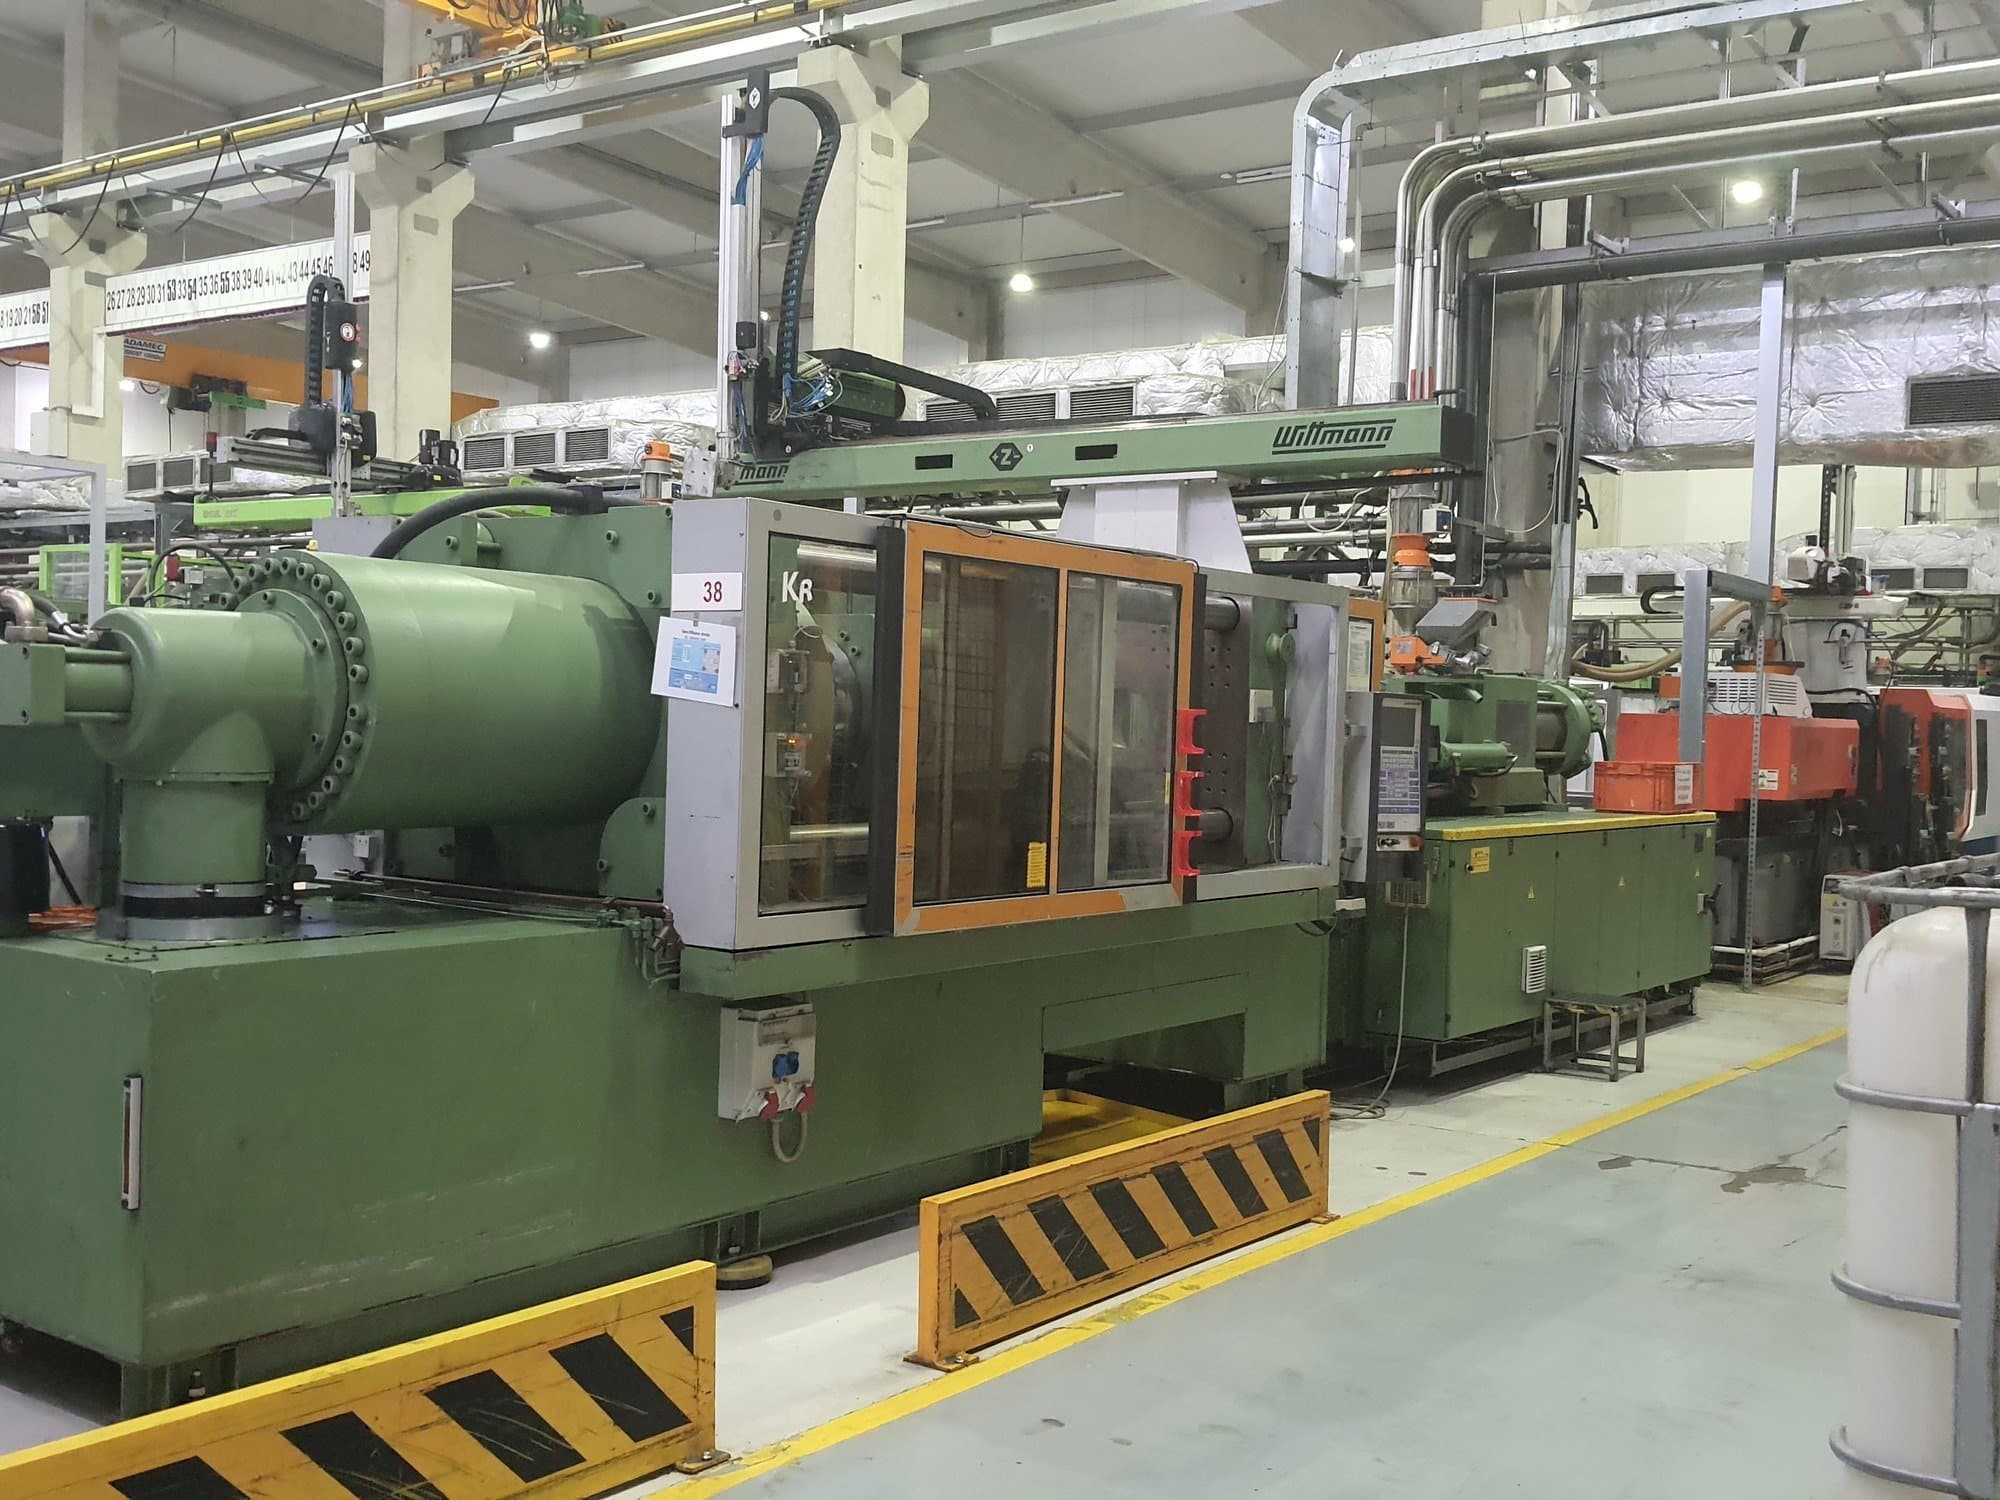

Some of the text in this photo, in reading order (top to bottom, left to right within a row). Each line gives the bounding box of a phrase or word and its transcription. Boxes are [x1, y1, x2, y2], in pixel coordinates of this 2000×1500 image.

[107, 291, 115, 311] 26
[117, 289, 125, 309] 27
[127, 287, 135, 308] 28
[137, 286, 145, 306] 29
[147, 284, 155, 304] 30
[157, 283, 165, 303] 31
[167, 278, 176, 301] 53
[178, 279, 186, 300] 33
[187, 278, 197, 301] 54
[199, 275, 207, 296] 35
[209, 273, 218, 295] 36
[220, 271, 230, 294] 55
[231, 270, 240, 291] 38
[242, 268, 251, 290] 39
[253, 266, 263, 288] 40
[288, 261, 297, 283] 43
[299, 259, 309, 281] 44
[323, 255, 333, 277] 46
[360, 249, 370, 272] 49
[703, 580, 722, 603] 38
